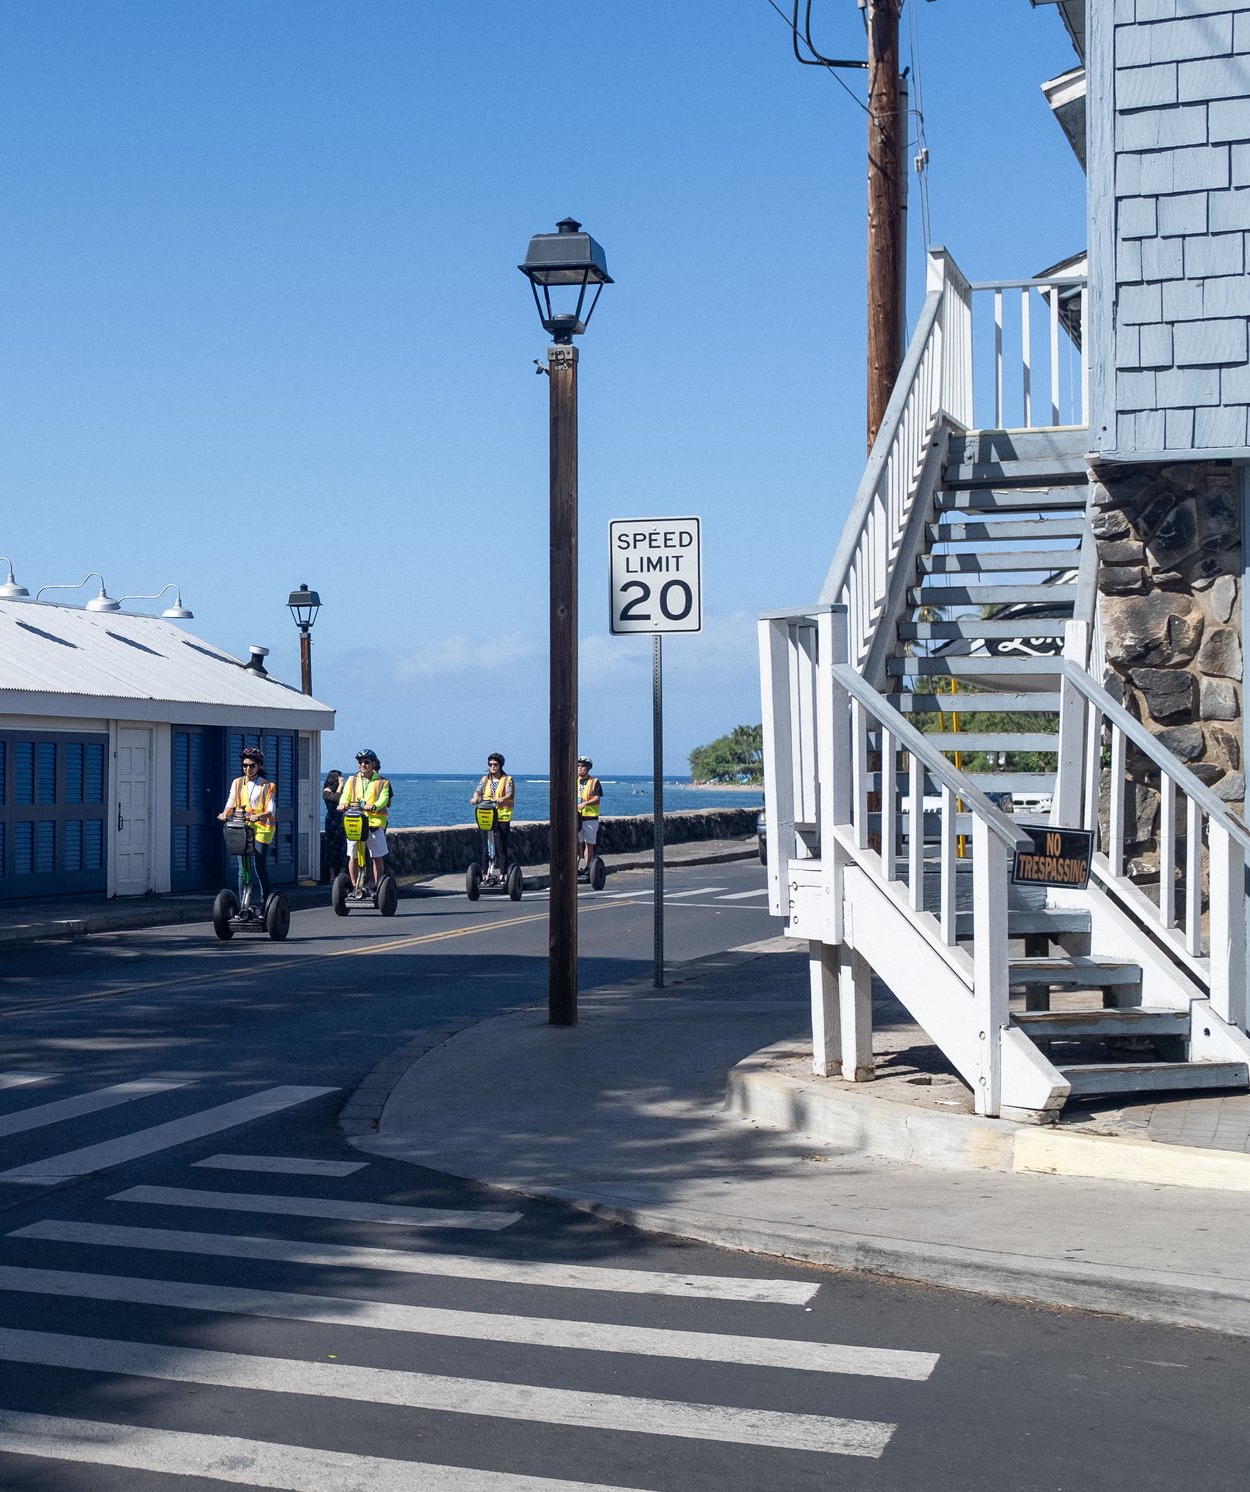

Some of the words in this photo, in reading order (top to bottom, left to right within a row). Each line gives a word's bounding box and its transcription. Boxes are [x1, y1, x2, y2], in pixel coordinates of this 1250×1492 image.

[617, 531, 693, 550] SPEED
[626, 555, 684, 573] LIMIT
[619, 579, 693, 621] 20
[1046, 833, 1062, 856] NO
[1019, 855, 1086, 883] TRESPASSING
